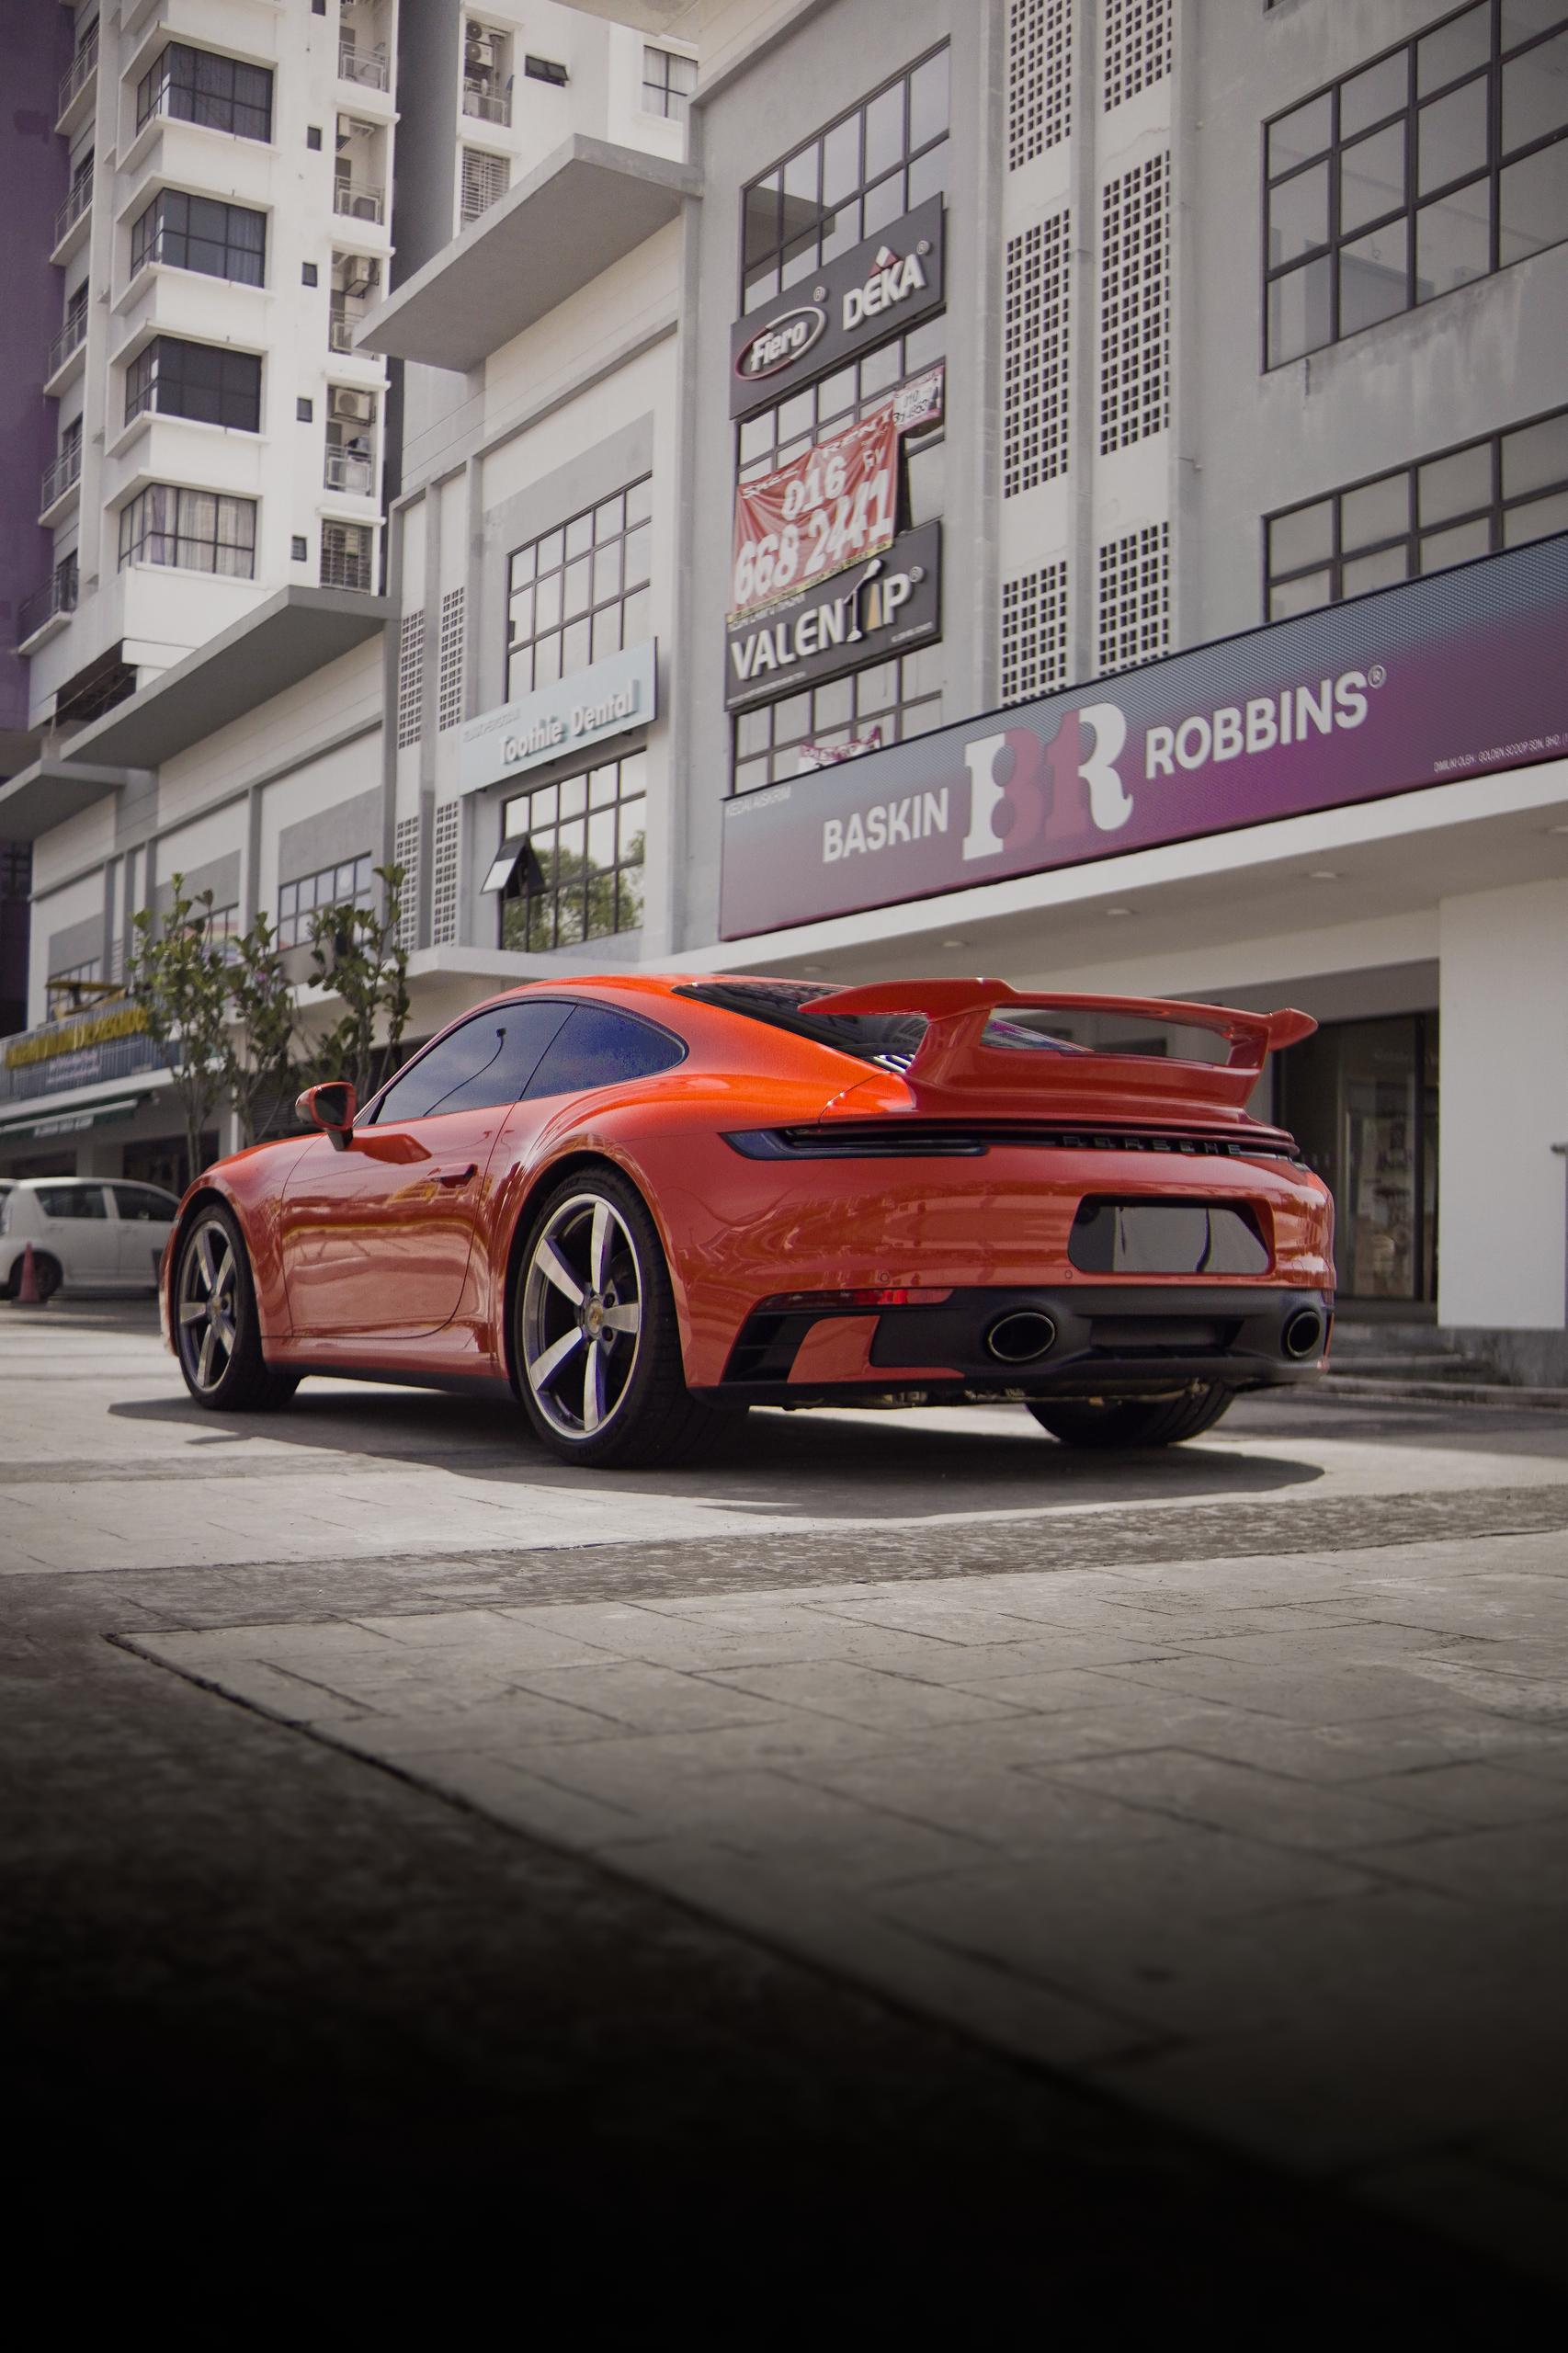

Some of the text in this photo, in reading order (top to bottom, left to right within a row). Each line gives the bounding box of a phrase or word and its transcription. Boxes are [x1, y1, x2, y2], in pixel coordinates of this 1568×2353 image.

[842, 253, 927, 331] DEKA
[749, 321, 809, 372] Fiero
[781, 455, 846, 521] 016
[735, 524, 800, 605] 668
[804, 469, 892, 577] 2441
[499, 715, 565, 765] Toothie
[571, 678, 640, 736] Dental
[822, 787, 949, 864] BASKIN
[1145, 670, 1369, 780] ROBBINS
[1062, 1134, 1243, 1156] PORSCHE
